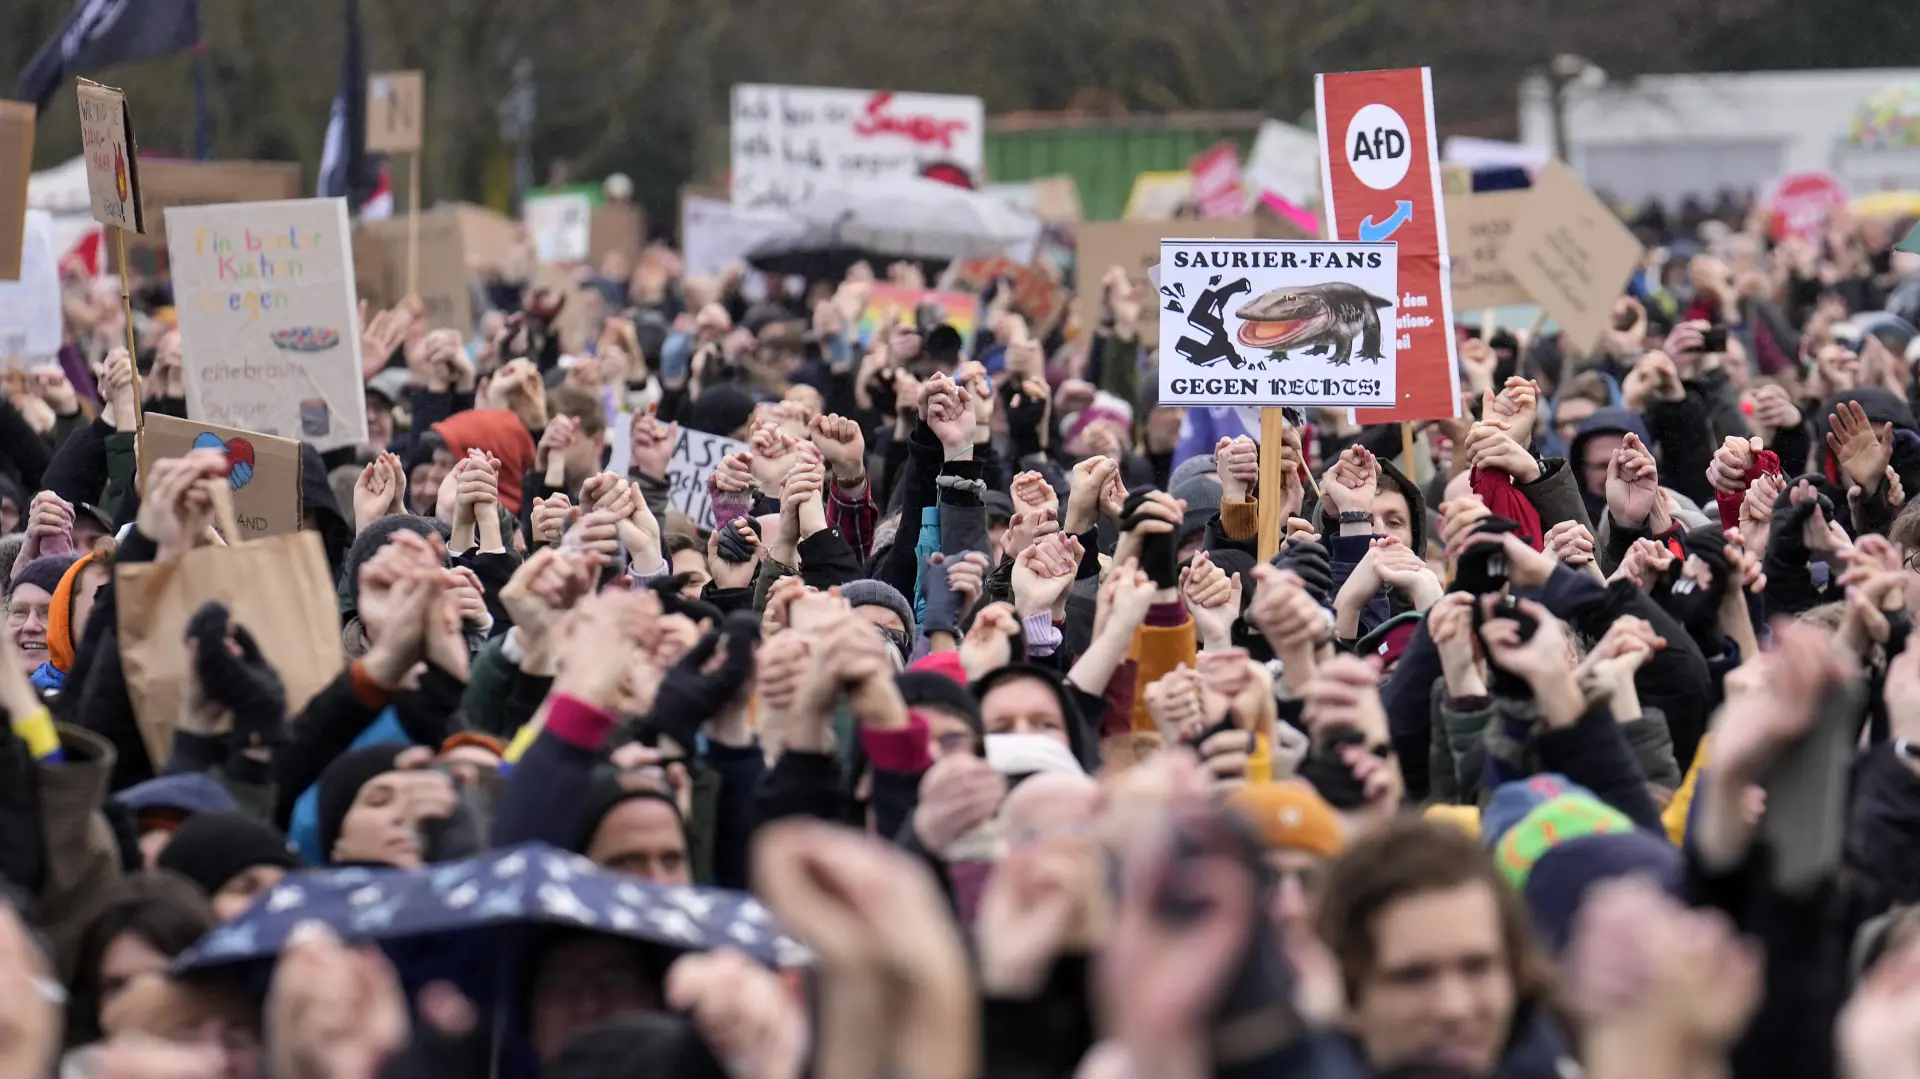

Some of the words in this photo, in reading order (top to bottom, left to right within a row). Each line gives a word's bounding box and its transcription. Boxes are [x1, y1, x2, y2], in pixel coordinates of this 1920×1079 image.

[1353, 126, 1405, 161] AfD
[1174, 251, 1382, 268] SAURIER-FANS
[1402, 291, 1428, 308] dem
[1396, 313, 1434, 330] ations-
[1396, 333, 1411, 350] eil
[1170, 378, 1259, 396] GEGEN
[236, 513, 268, 531] AND
